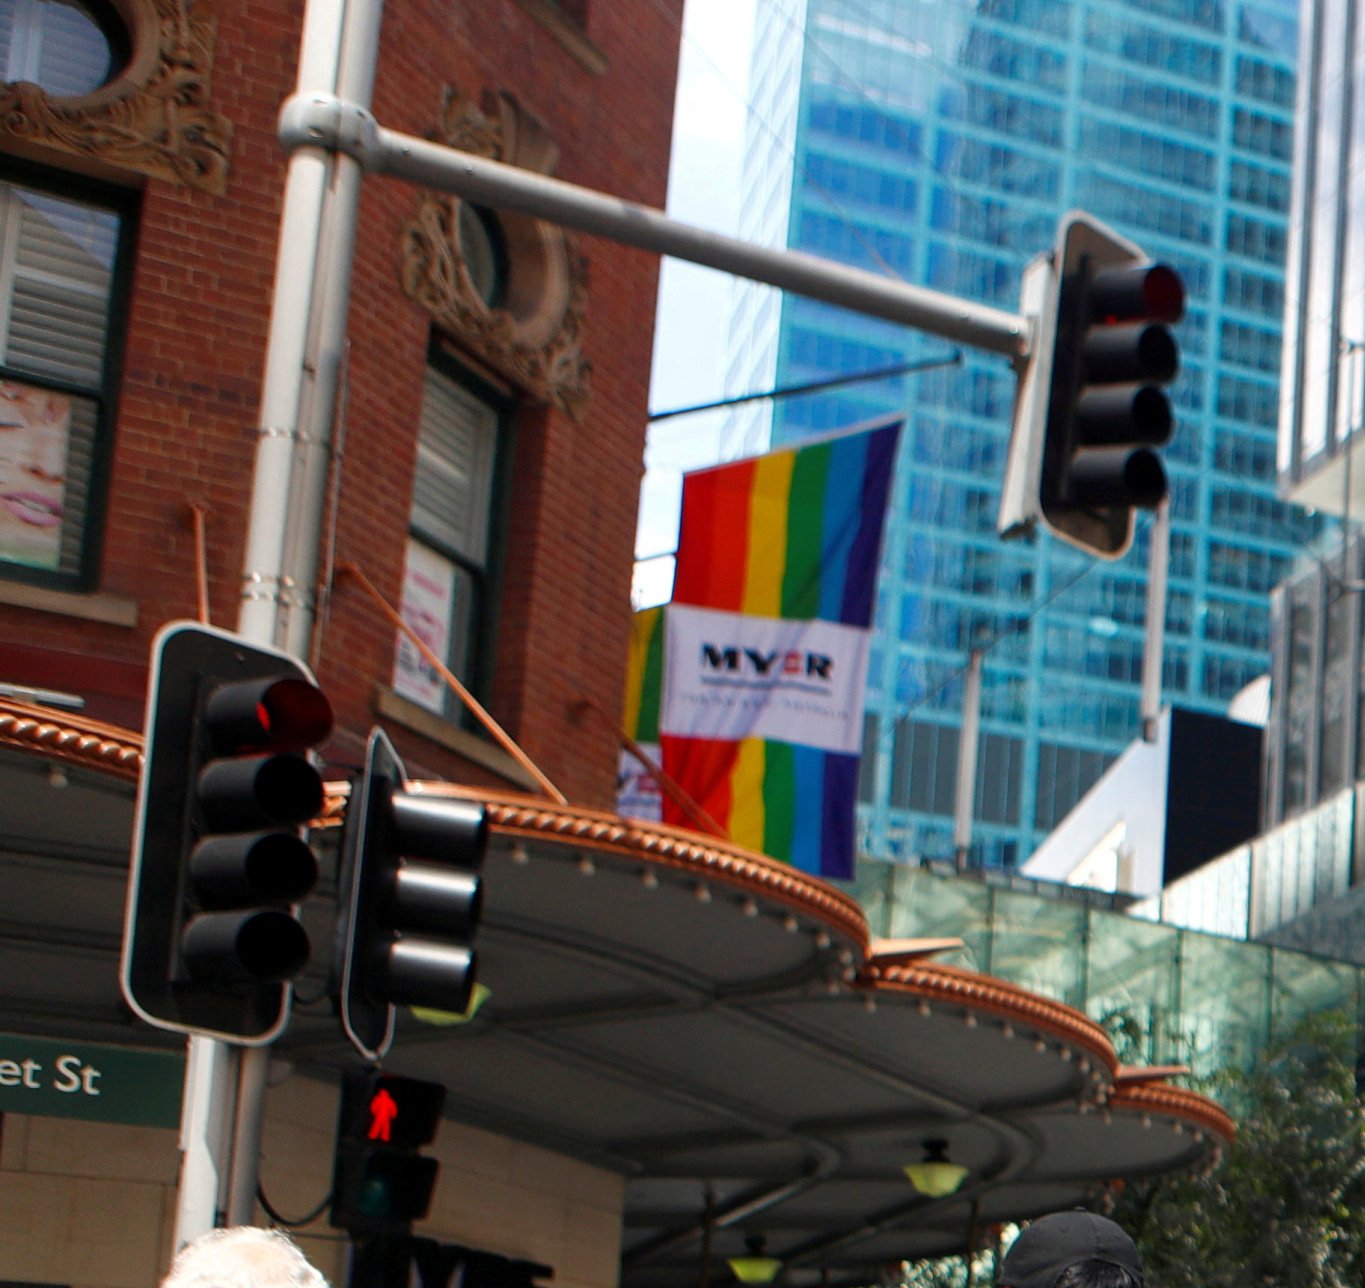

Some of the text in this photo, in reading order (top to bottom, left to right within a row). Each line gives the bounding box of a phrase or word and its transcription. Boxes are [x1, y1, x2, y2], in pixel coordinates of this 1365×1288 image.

[702, 642, 835, 680] MYER
[0, 1055, 101, 1096] et St
